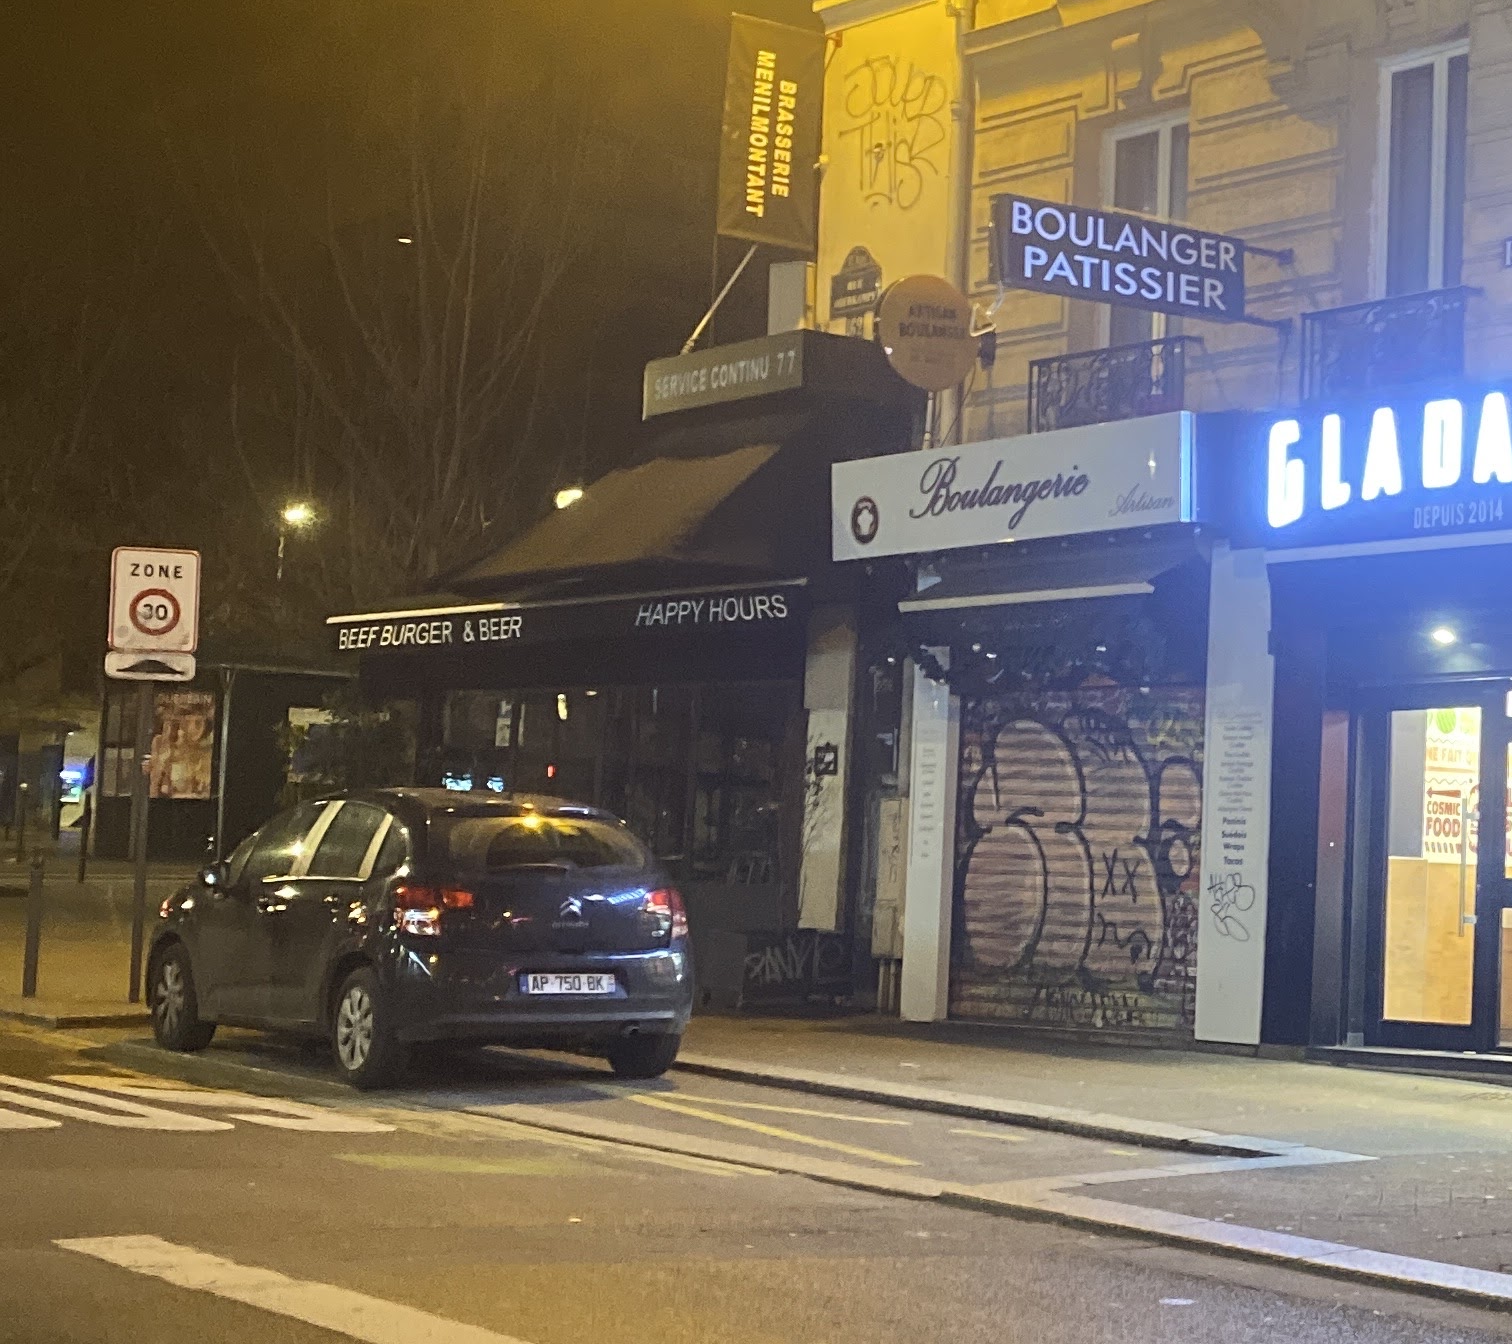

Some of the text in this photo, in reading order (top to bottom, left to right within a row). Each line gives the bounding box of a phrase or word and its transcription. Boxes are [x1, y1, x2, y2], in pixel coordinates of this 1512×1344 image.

[745, 50, 777, 219] MENILMONTANT
[771, 79, 798, 199] BRASSERIE
[1011, 200, 1238, 273] BOULANGER
[1024, 244, 1227, 311] PATISSIER
[654, 366, 707, 401] SERVICE
[710, 355, 770, 389] CONTINU
[909, 456, 1091, 531] Boulangerie
[1413, 496, 1504, 530] DEPUIS 2014
[130, 562, 184, 579] ZONE
[142, 603, 168, 621] 30
[635, 594, 789, 627] HAPPY HOURS
[338, 616, 523, 650] BEEF BURGER & BEER
[1426, 800, 1461, 817] COSMIC
[1425, 816, 1461, 838] FOOD
